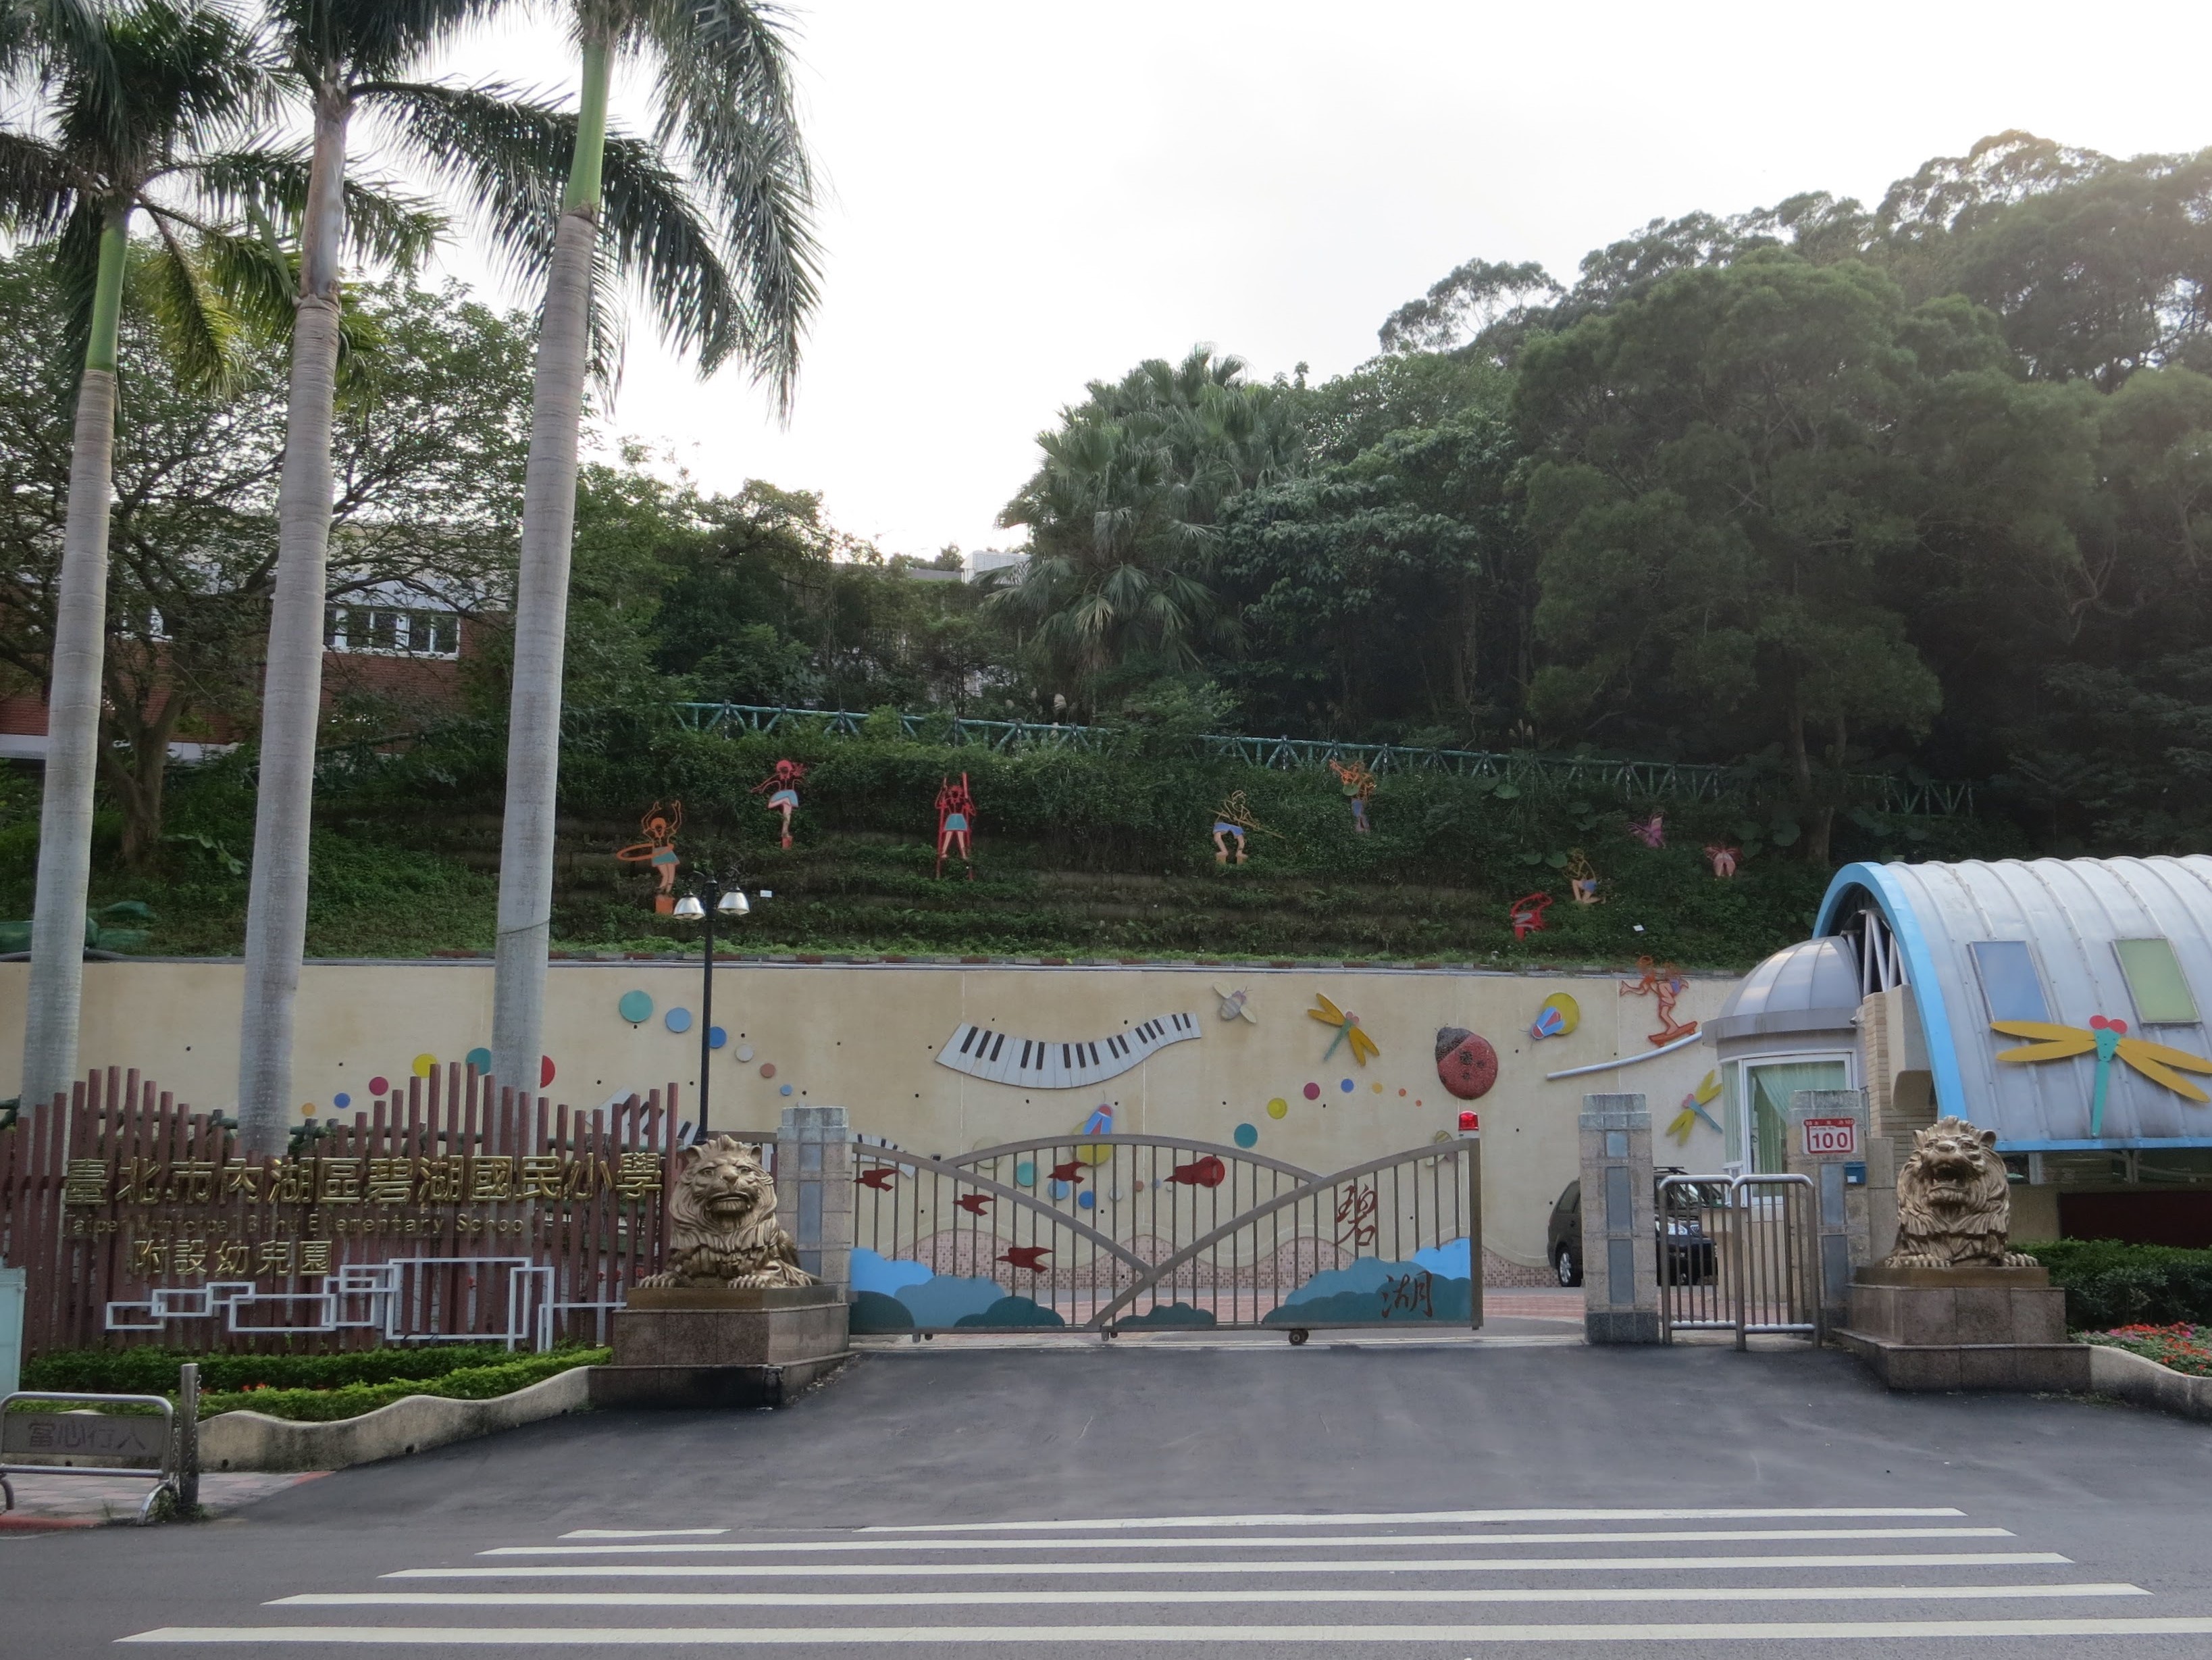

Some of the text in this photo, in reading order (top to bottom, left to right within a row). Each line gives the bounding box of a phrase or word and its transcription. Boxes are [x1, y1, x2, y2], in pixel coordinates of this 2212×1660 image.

[1812, 1132, 1848, 1149] 100
[65, 1153, 663, 1205] 臺北市內湖區碧湖國民小學
[134, 1238, 333, 1276] 附設幼兒園
[1381, 1270, 1433, 1318] 湖
[28, 1422, 147, 1451] 當心行人
